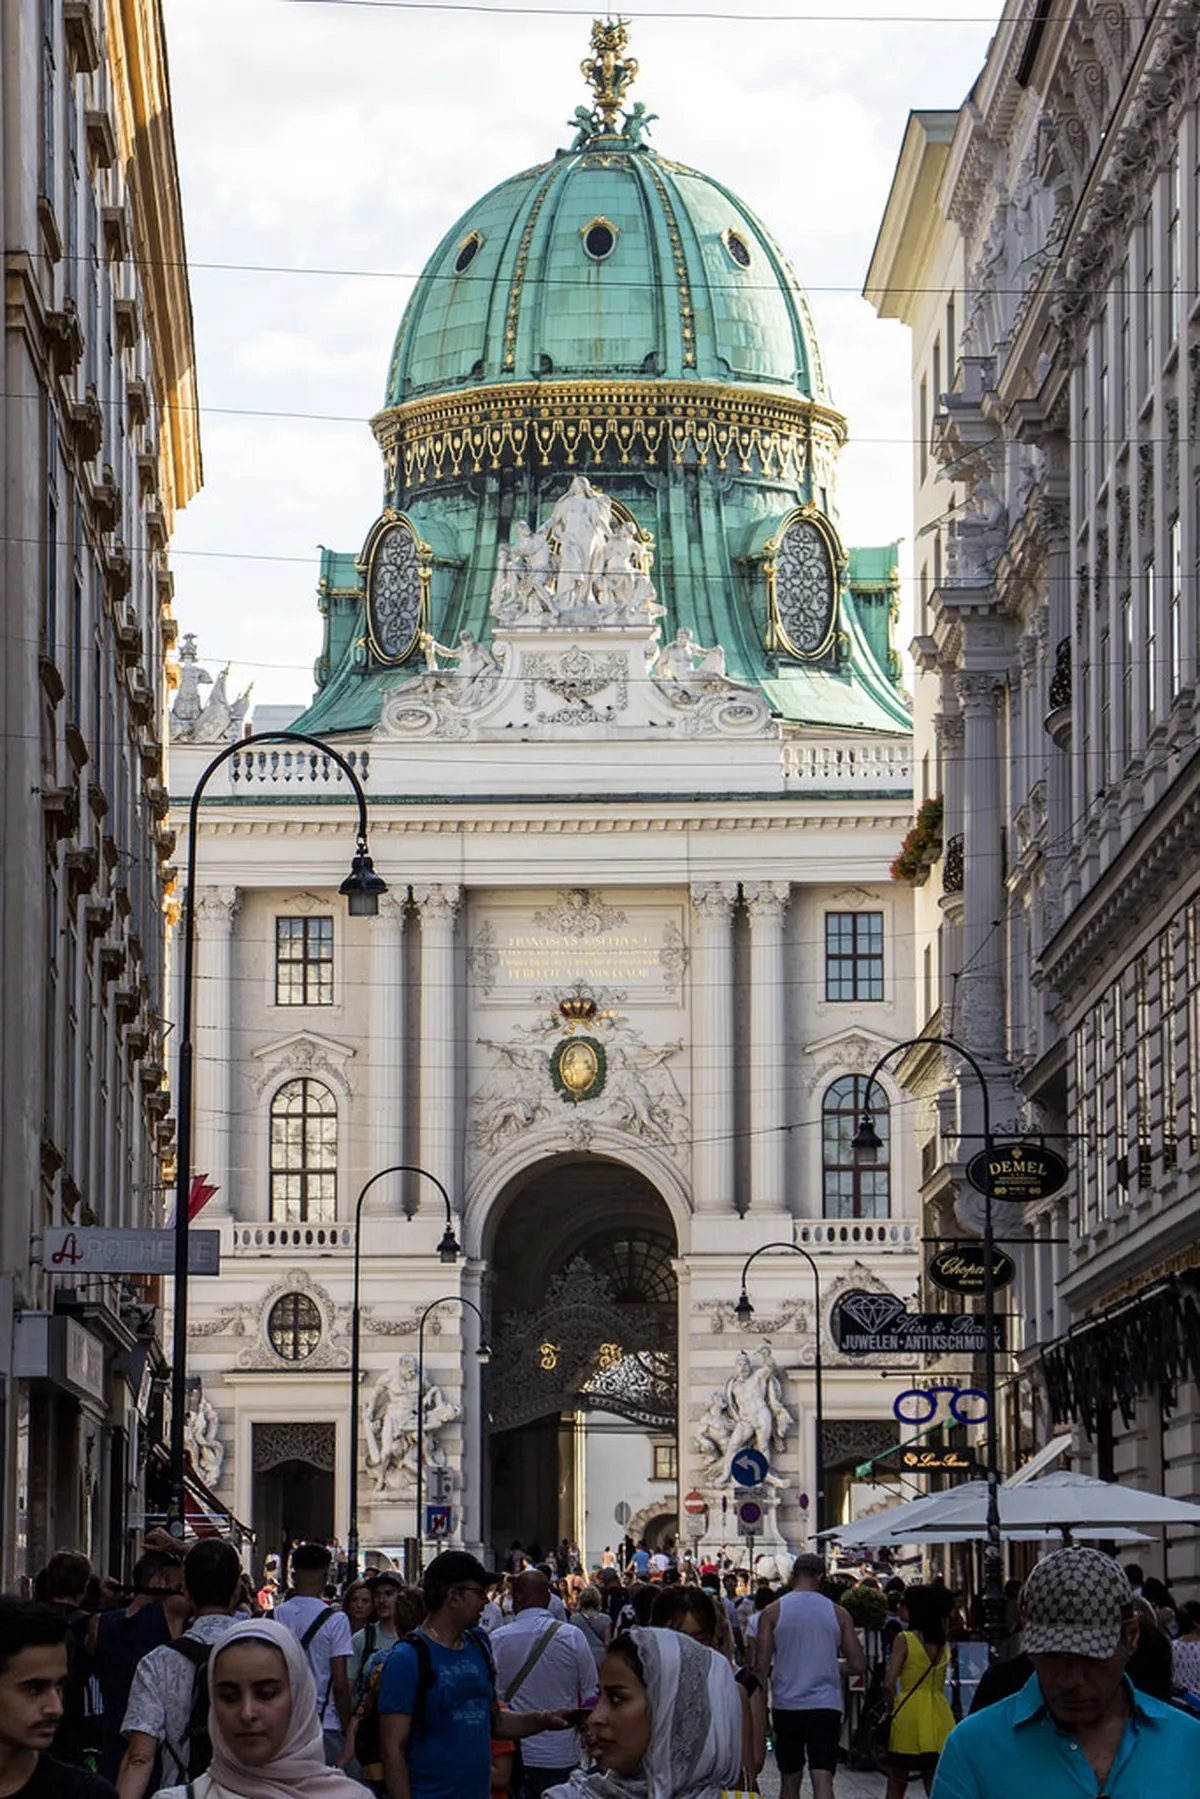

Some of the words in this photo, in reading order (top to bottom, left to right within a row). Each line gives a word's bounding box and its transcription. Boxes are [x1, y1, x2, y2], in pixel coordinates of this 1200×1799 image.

[988, 1160, 1048, 1176] DEMEL
[51, 1232, 213, 1265] APOTHEE
[935, 1255, 1006, 1279] Chopad
[891, 1314, 928, 1334] Kiss
[931, 1321, 946, 1333] &
[904, 1335, 1001, 1350] ANTIKSCHMUK
